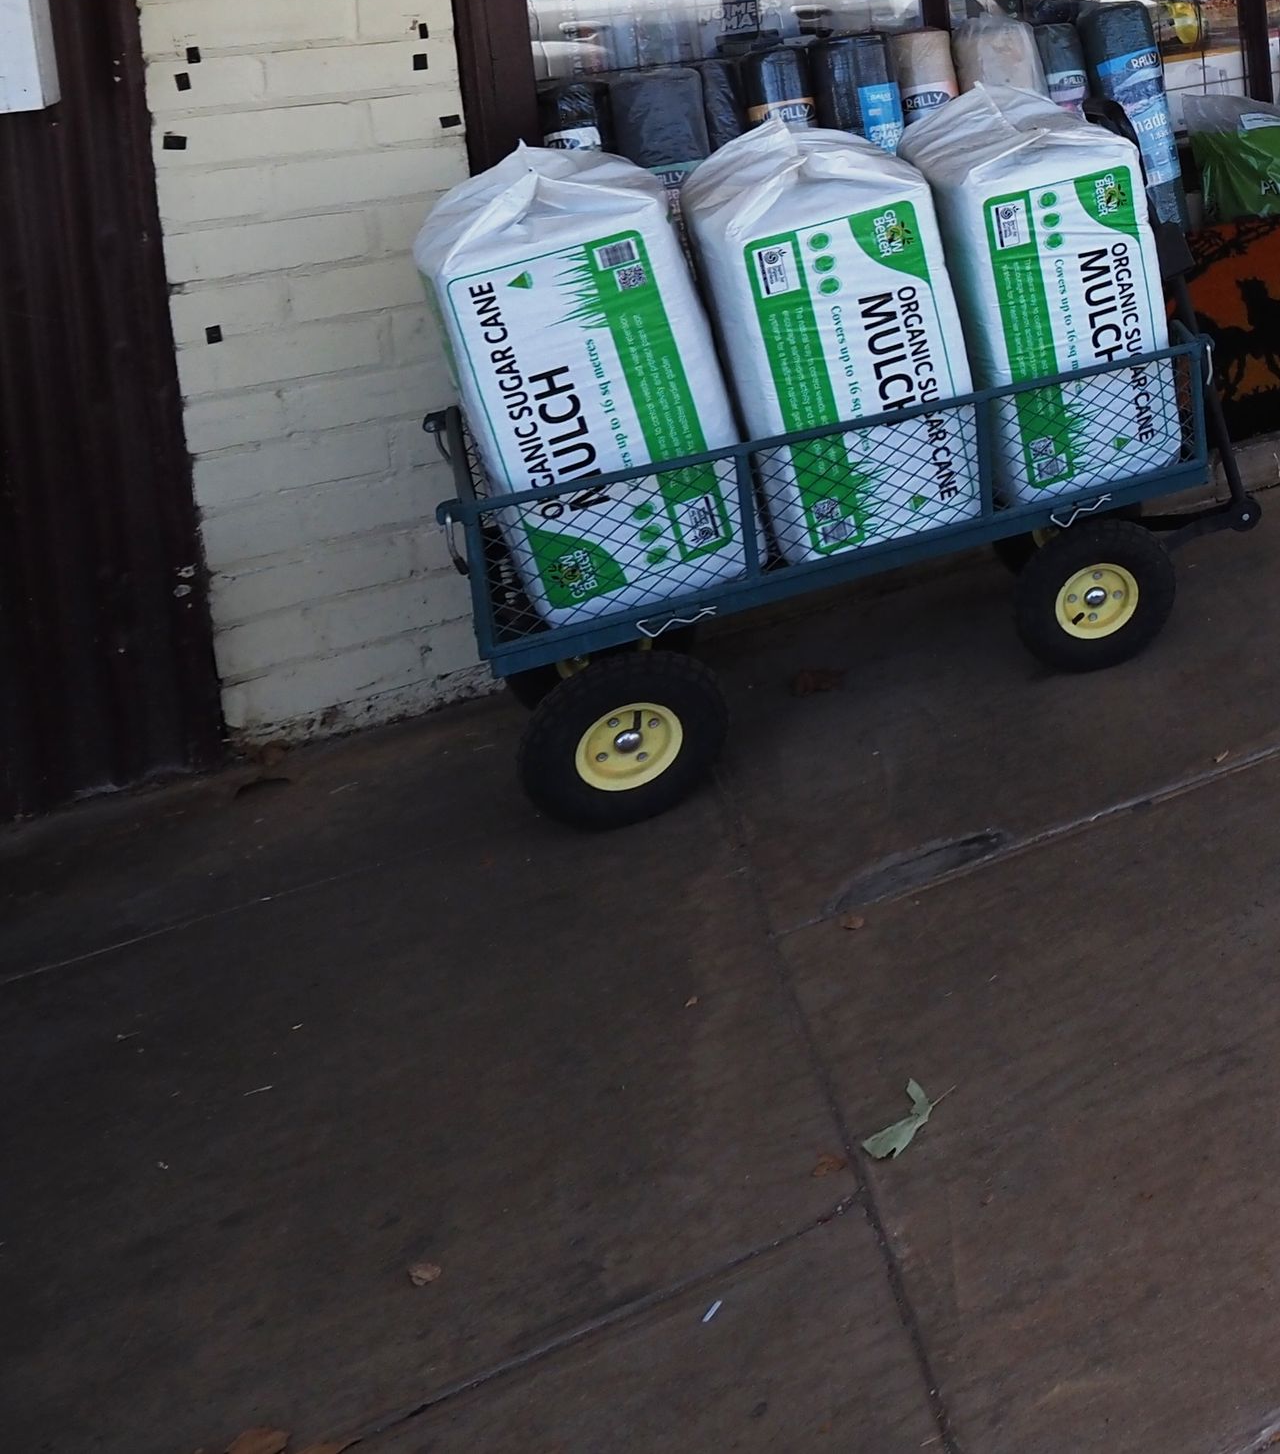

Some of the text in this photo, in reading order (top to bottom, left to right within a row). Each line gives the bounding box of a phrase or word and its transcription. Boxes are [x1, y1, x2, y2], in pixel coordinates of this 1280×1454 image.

[906, 91, 943, 109] RALLY
[1062, 74, 1087, 85] RALLY
[1130, 50, 1160, 69] RALLY
[1132, 112, 1168, 134] hade
[469, 281, 509, 344] CANE
[827, 304, 862, 412] Covers up to 16 sq
[1052, 258, 1078, 358] Covers up to 16 sq
[1108, 241, 1140, 326] ORGANIC
[1130, 390, 1157, 441] CANE
[491, 345, 533, 421] SUGAR
[581, 337, 628, 449] up to 16 sq metres
[893, 284, 936, 377] ORGANIC
[928, 444, 961, 501] CANE
[514, 420, 565, 521] OGANIC
[528, 365, 611, 513] MULCH
